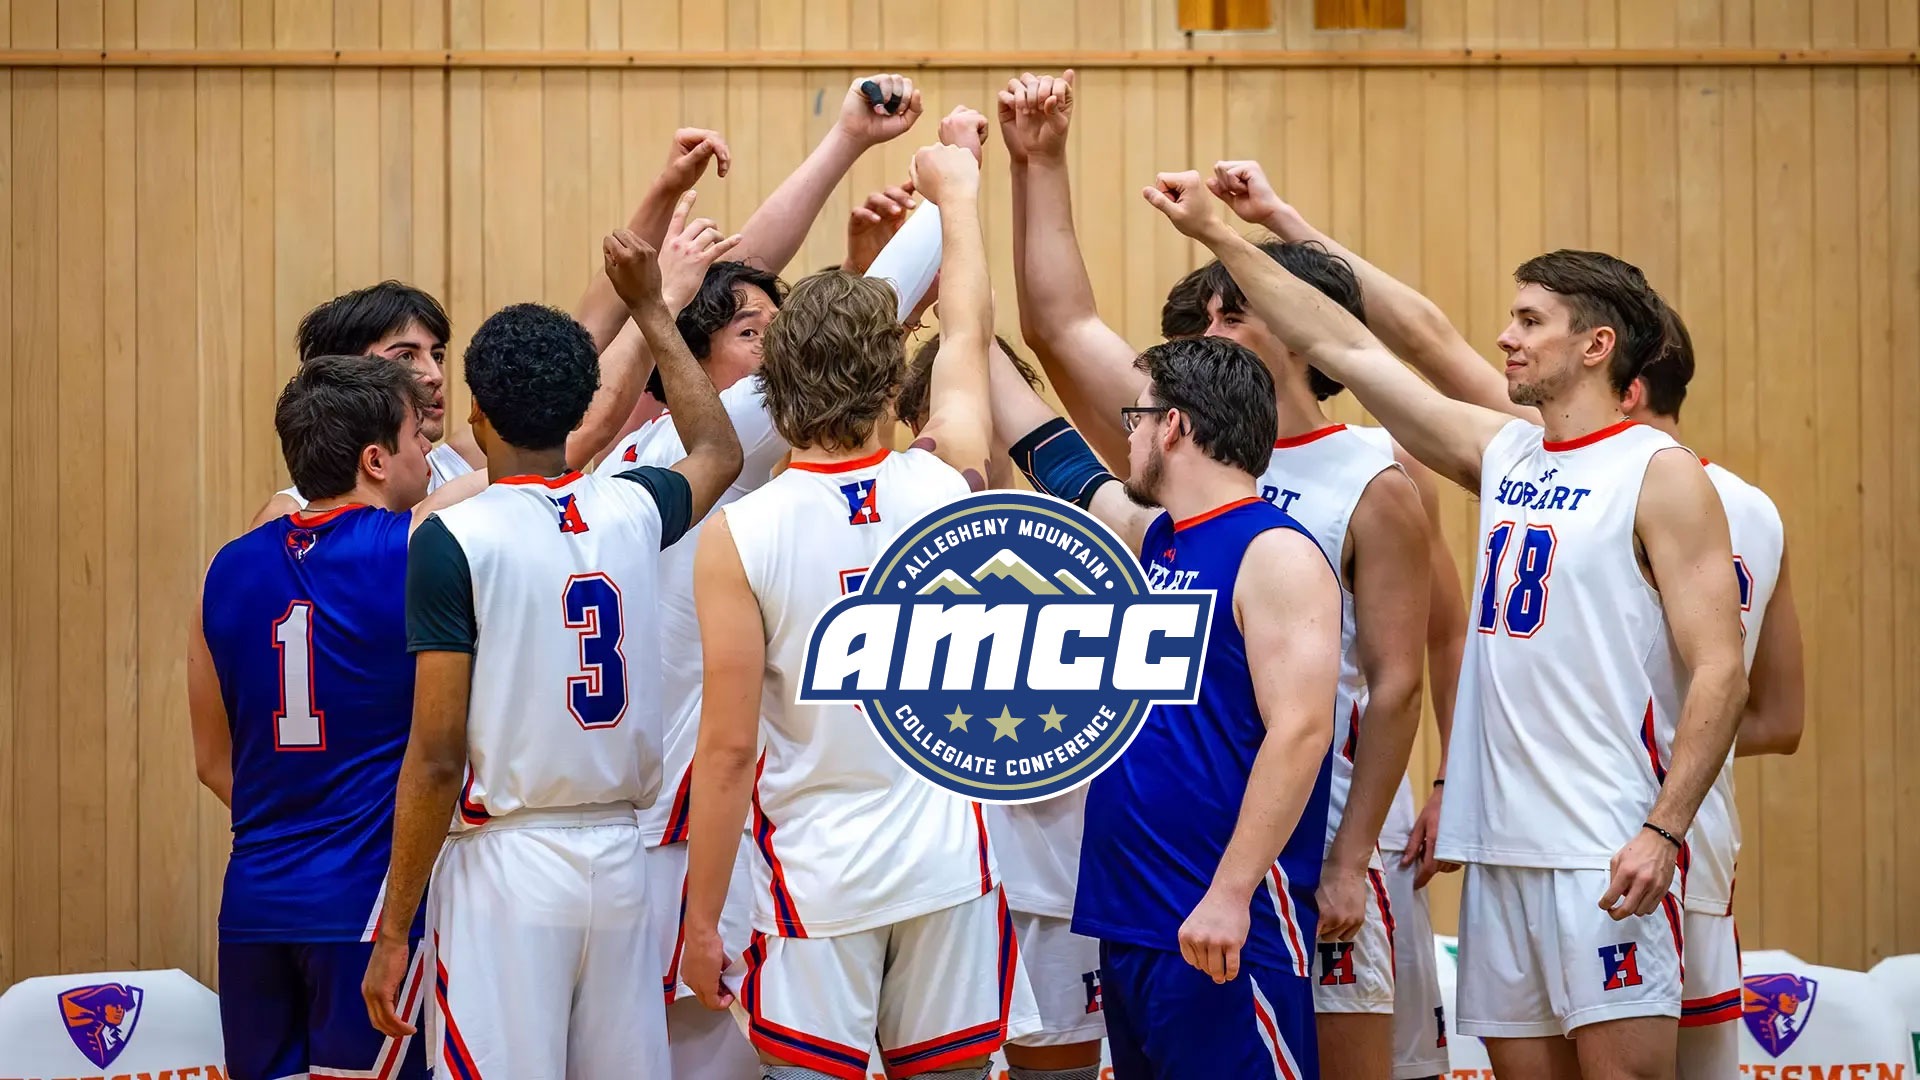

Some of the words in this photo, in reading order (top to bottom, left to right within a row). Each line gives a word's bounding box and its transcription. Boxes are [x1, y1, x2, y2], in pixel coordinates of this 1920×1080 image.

[1495, 475, 1592, 511] HOBART
[1477, 521, 1557, 639] 18
[271, 599, 327, 752] 1
[561, 571, 630, 731] 3
